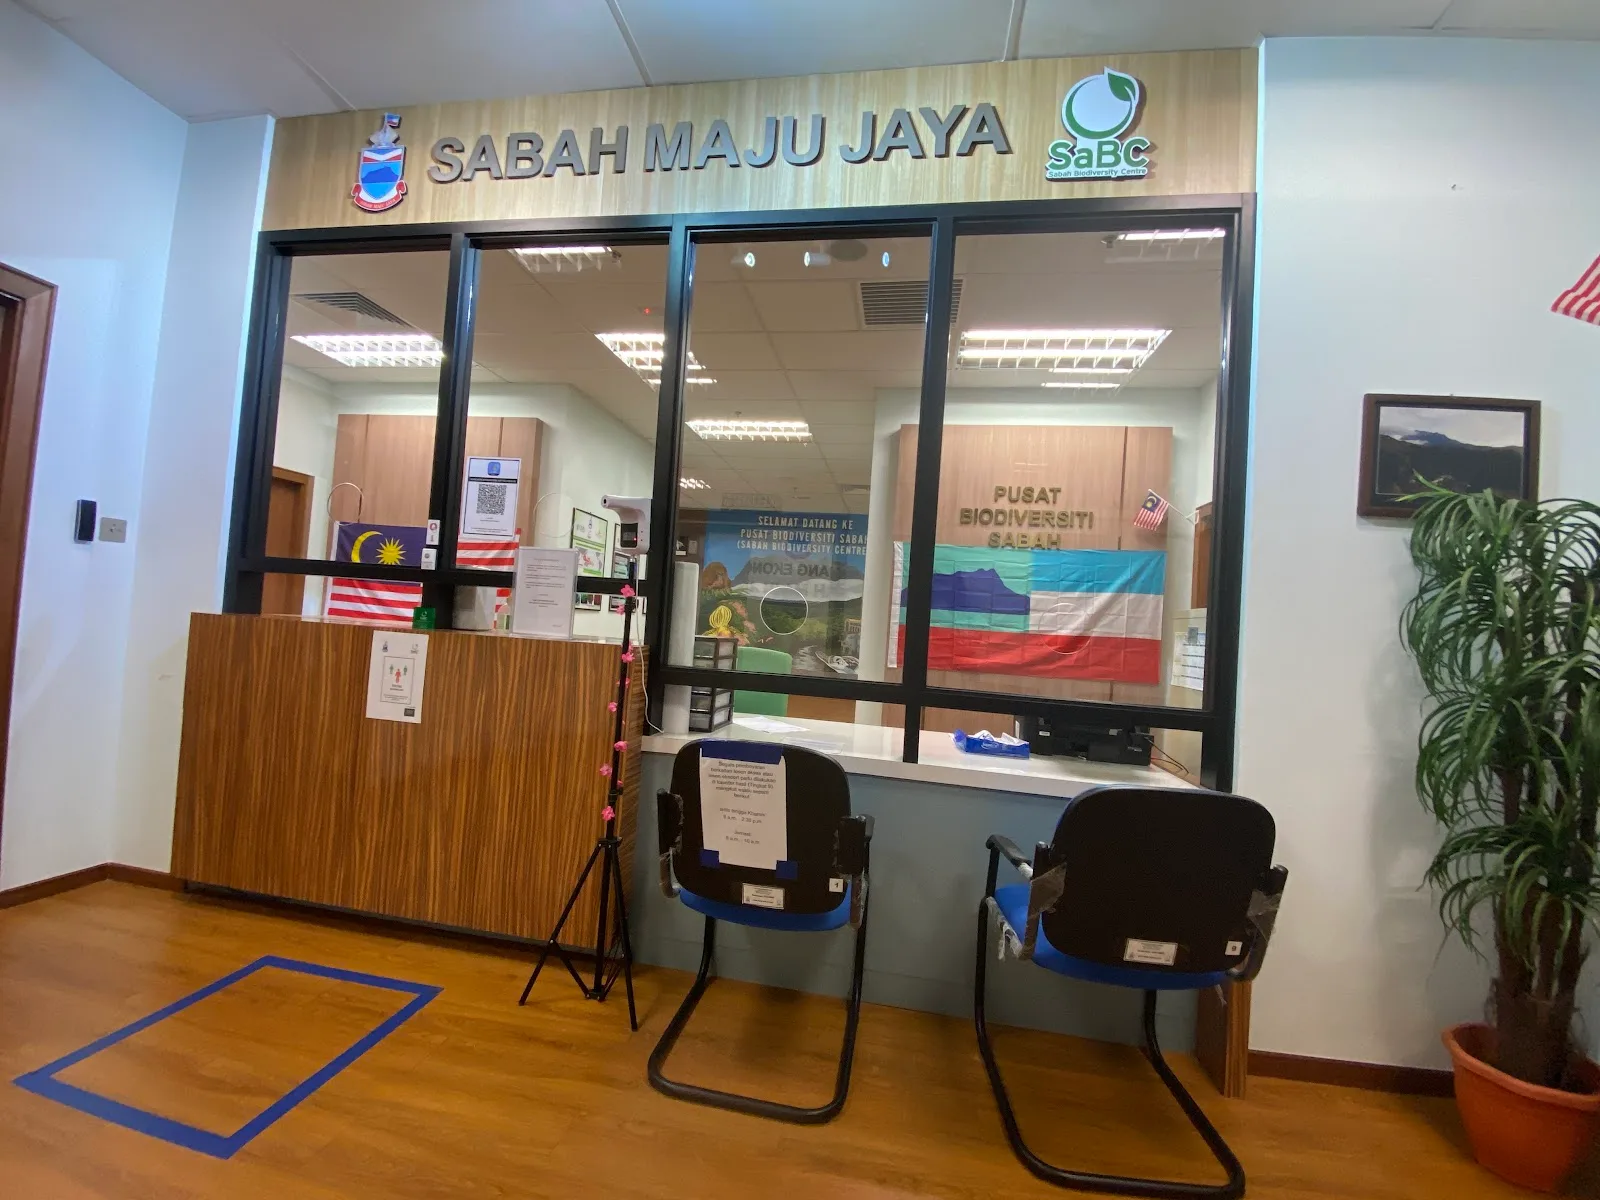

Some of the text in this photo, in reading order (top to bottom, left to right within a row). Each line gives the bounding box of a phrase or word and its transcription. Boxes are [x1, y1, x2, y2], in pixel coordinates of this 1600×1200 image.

[428, 103, 1014, 184] SABAH MAJU JAYA
[1047, 137, 1150, 171] SaBC
[1048, 167, 1147, 178] Sabah Biodiversity Centre
[994, 486, 1062, 504] PUSAT
[758, 515, 854, 530] SELAMAT DATANG KE
[959, 507, 1094, 529] BIODIVERSITI
[740, 528, 769, 540] PUSAT
[772, 530, 836, 544] BIODIVERSITI
[987, 531, 1062, 550] SABAH
[771, 541, 831, 554] BIODIVERSITY
